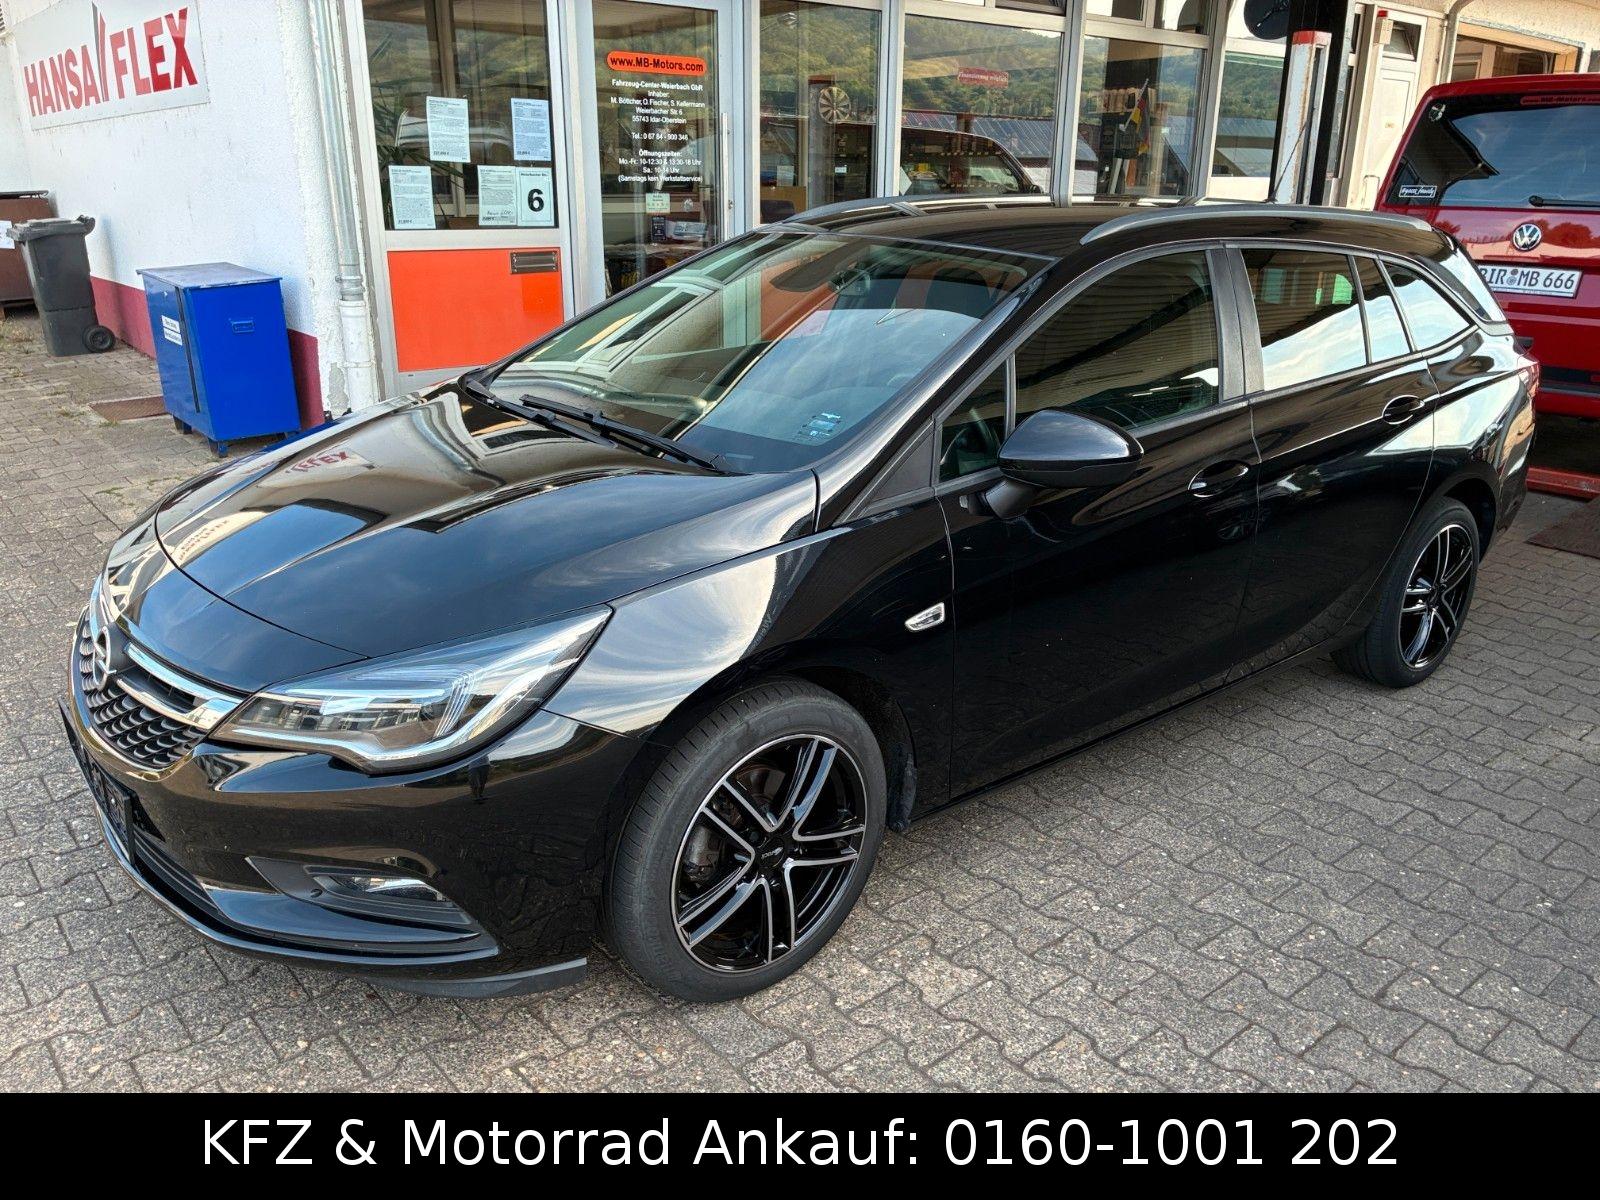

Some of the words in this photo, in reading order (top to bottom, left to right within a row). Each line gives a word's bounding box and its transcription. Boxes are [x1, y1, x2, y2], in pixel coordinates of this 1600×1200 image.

[24, 44, 102, 117] HANSA
[109, 7, 198, 99] FLEX
[610, 57, 703, 71] www.MB-Motors.com
[612, 79, 690, 91] Fahrzeug-Center-Weierbach
[691, 83, 703, 91] GbR
[648, 90, 669, 98] Inhaber:
[650, 116, 687, 124] Idar-Oberstein
[639, 148, 682, 157] Öffnungszeiten:
[618, 175, 647, 183] (Samstags
[659, 175, 703, 183] Werkstattservice)
[527, 188, 545, 212] 6
[1517, 270, 1540, 287] MB
[1542, 271, 1575, 290] 666
